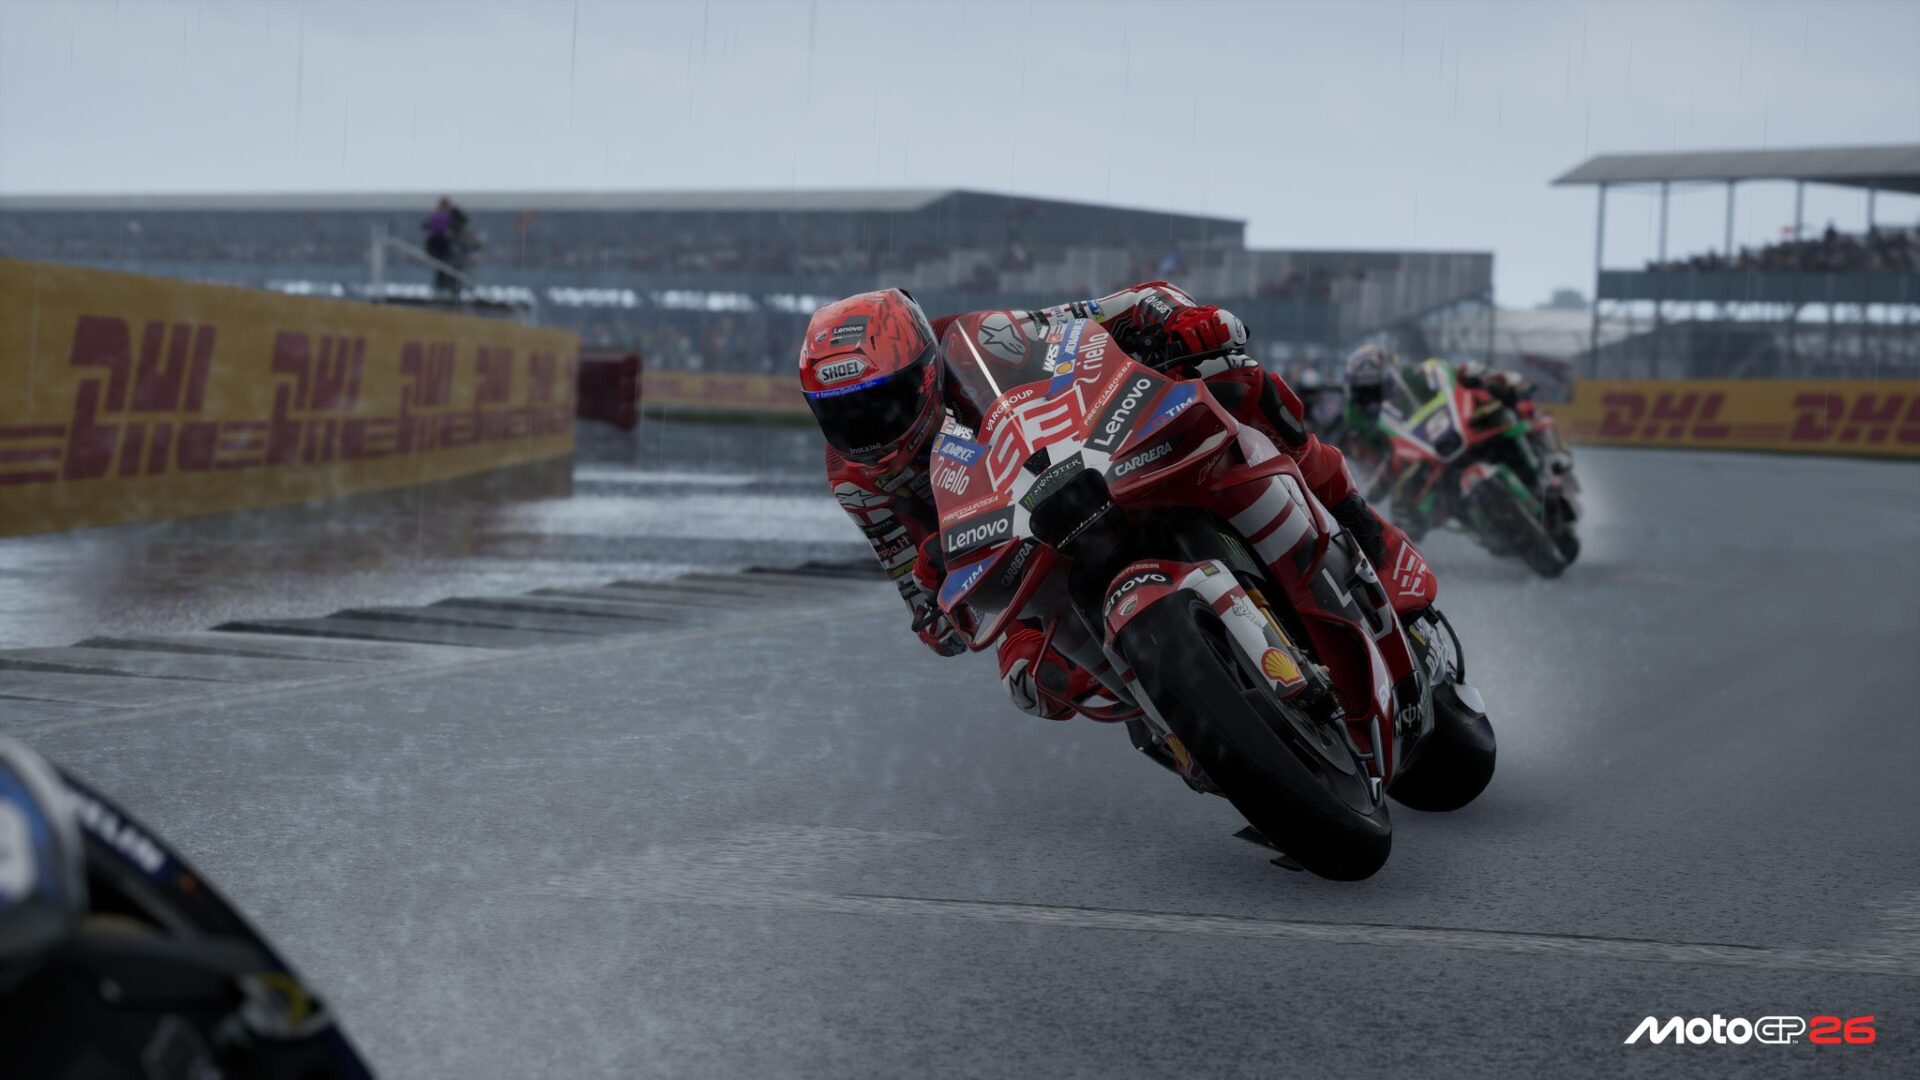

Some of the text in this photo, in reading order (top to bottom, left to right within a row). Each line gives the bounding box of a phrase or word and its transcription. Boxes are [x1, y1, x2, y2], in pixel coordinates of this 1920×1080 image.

[833, 325, 864, 335] Lenovo
[1076, 332, 1110, 371] riello
[821, 361, 859, 382] SHOEI
[986, 389, 1034, 432] VARGROUP
[1082, 360, 1133, 427] FRECCIAROSSA
[1093, 376, 1152, 447] Lenovo
[1166, 397, 1194, 418] TIM
[1599, 392, 1732, 440] DHL
[1114, 442, 1173, 477] CARRERA
[936, 461, 971, 497] riello
[947, 517, 1009, 552] Lenovo
[961, 563, 984, 593] TIM
[1001, 541, 1035, 588] CARRERA
[1104, 573, 1167, 618] enovo
